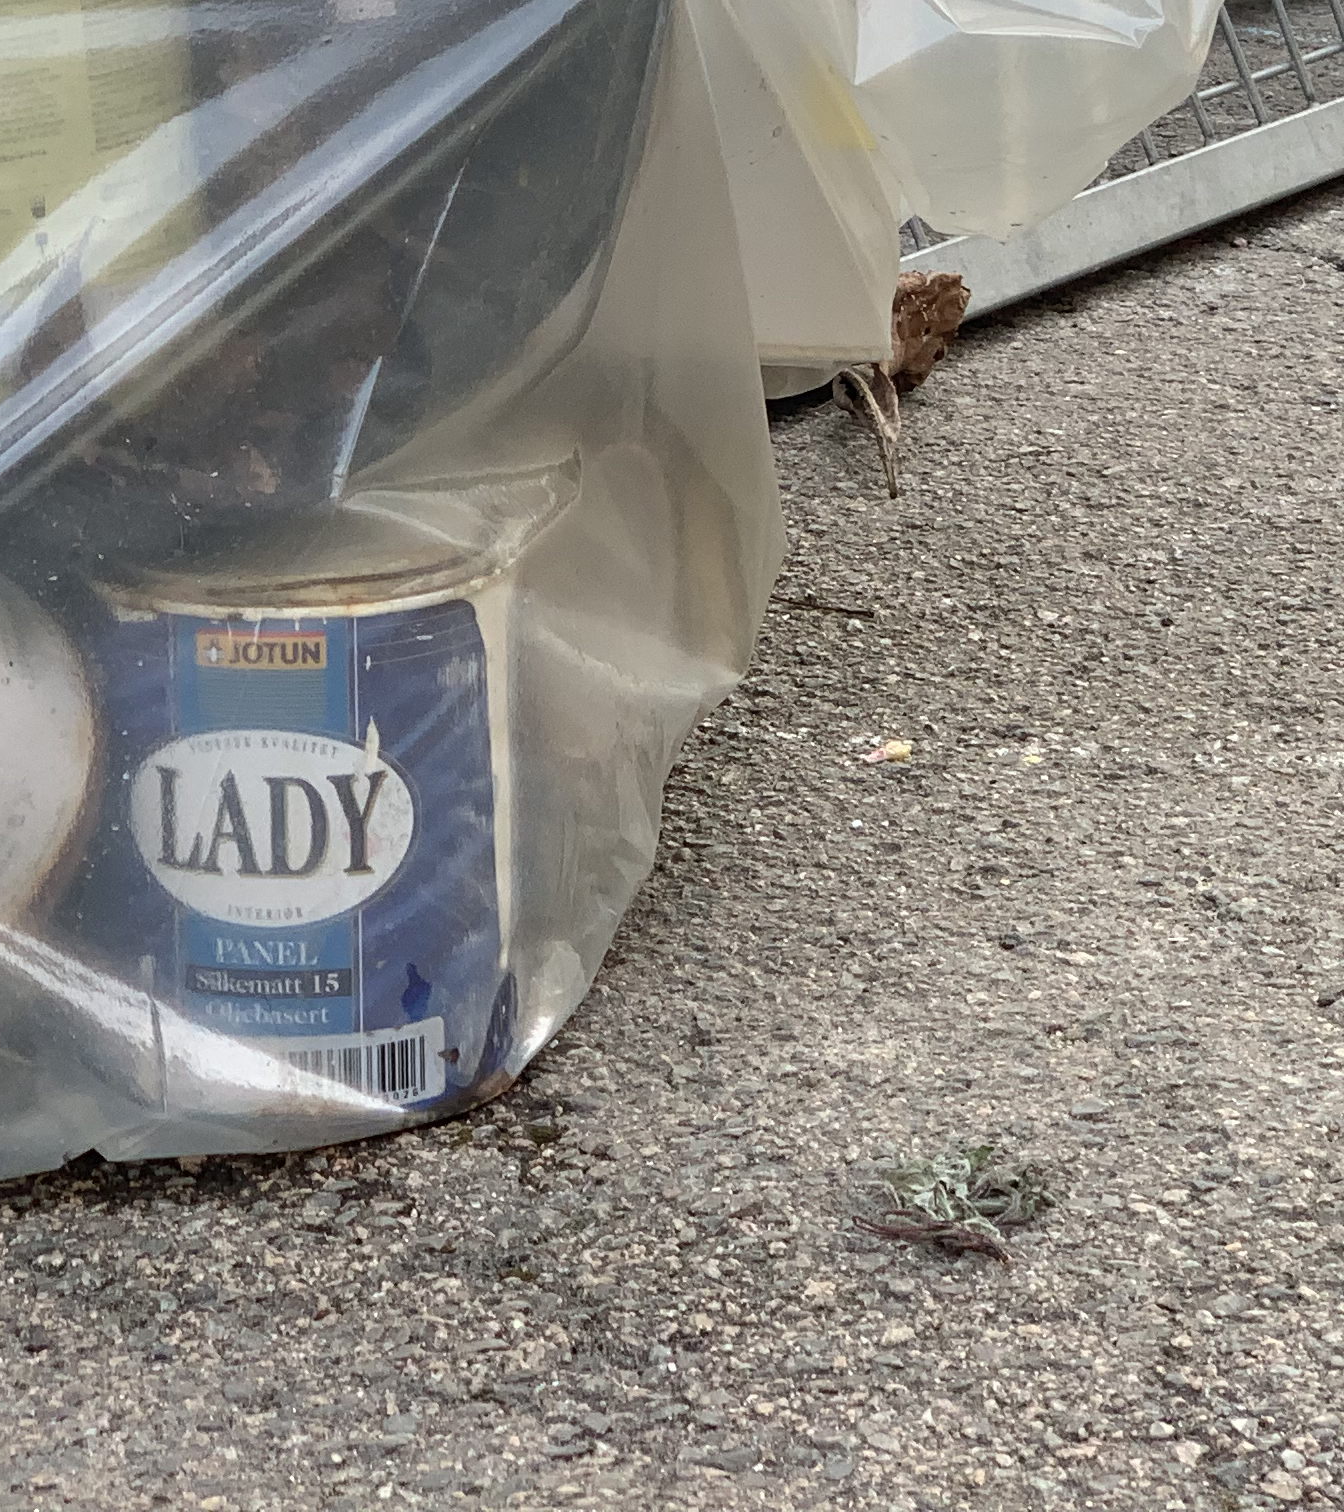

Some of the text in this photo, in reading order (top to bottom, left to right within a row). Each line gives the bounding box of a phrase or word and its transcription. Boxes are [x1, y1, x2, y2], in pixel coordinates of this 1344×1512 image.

[229, 642, 321, 665] JOTUN
[155, 765, 389, 879] LADY
[215, 938, 319, 966] PANEL
[312, 973, 340, 995] 15
